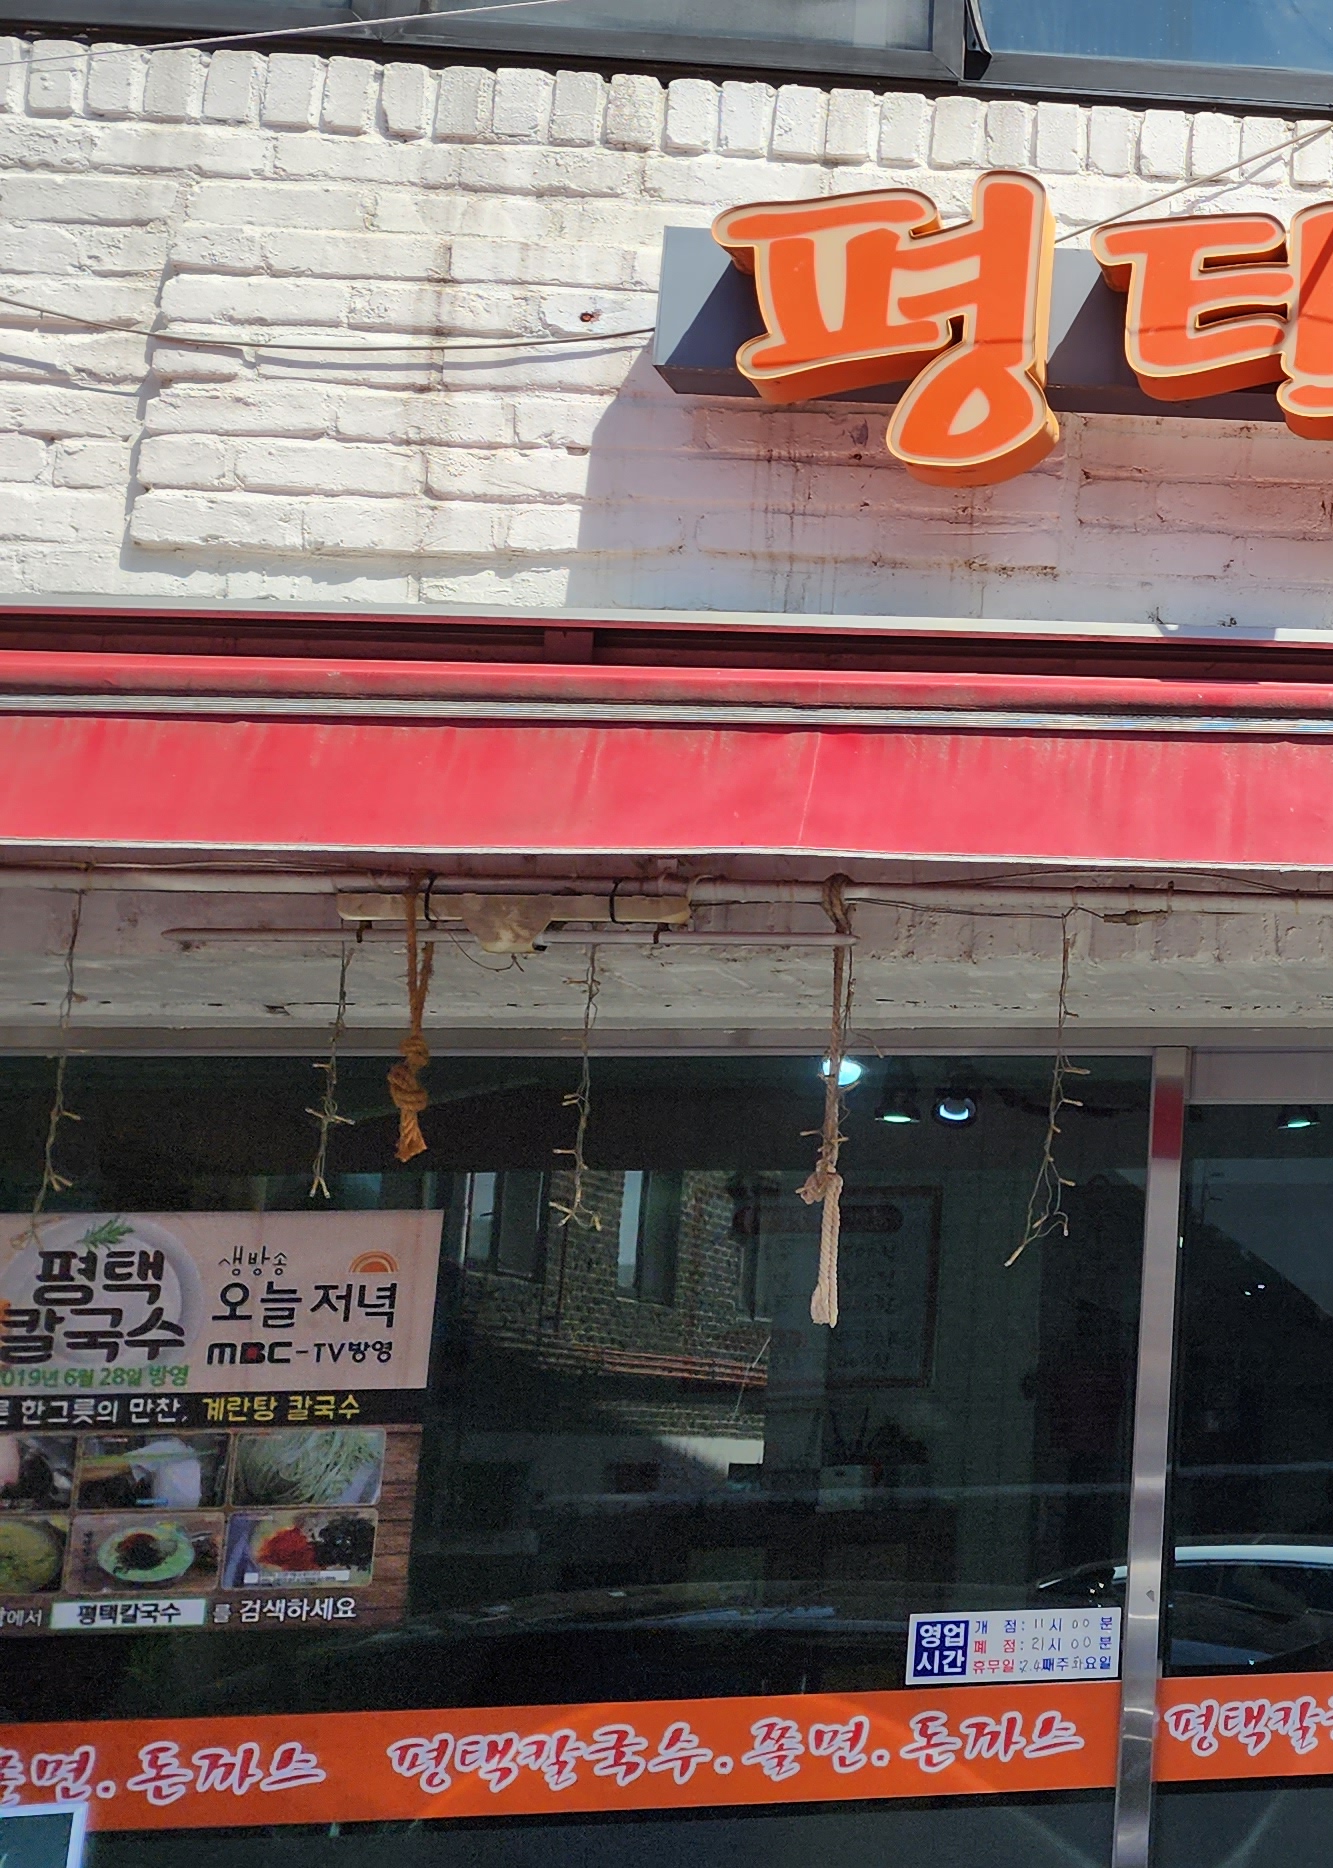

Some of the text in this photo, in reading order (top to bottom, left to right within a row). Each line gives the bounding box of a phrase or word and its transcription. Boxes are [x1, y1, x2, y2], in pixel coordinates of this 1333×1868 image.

[218, 1245, 288, 1277] 생방송
[32, 1249, 166, 1307] 평택
[0, 1306, 186, 1365] 칼국수
[0, 1367, 58, 1388] 019년
[99, 1366, 143, 1388] 28일
[149, 1364, 190, 1388] 방영
[21, 1399, 119, 1426] 한그릇의
[129, 1397, 189, 1424] 만찬,
[202, 1396, 278, 1422] 계란탕
[287, 1394, 361, 1421] 칼국수
[76, 1602, 182, 1626] 평택칼국수
[239, 1596, 358, 1624] 검색하세요
[919, 1622, 967, 1649] 영업
[916, 1650, 966, 1675] 시간
